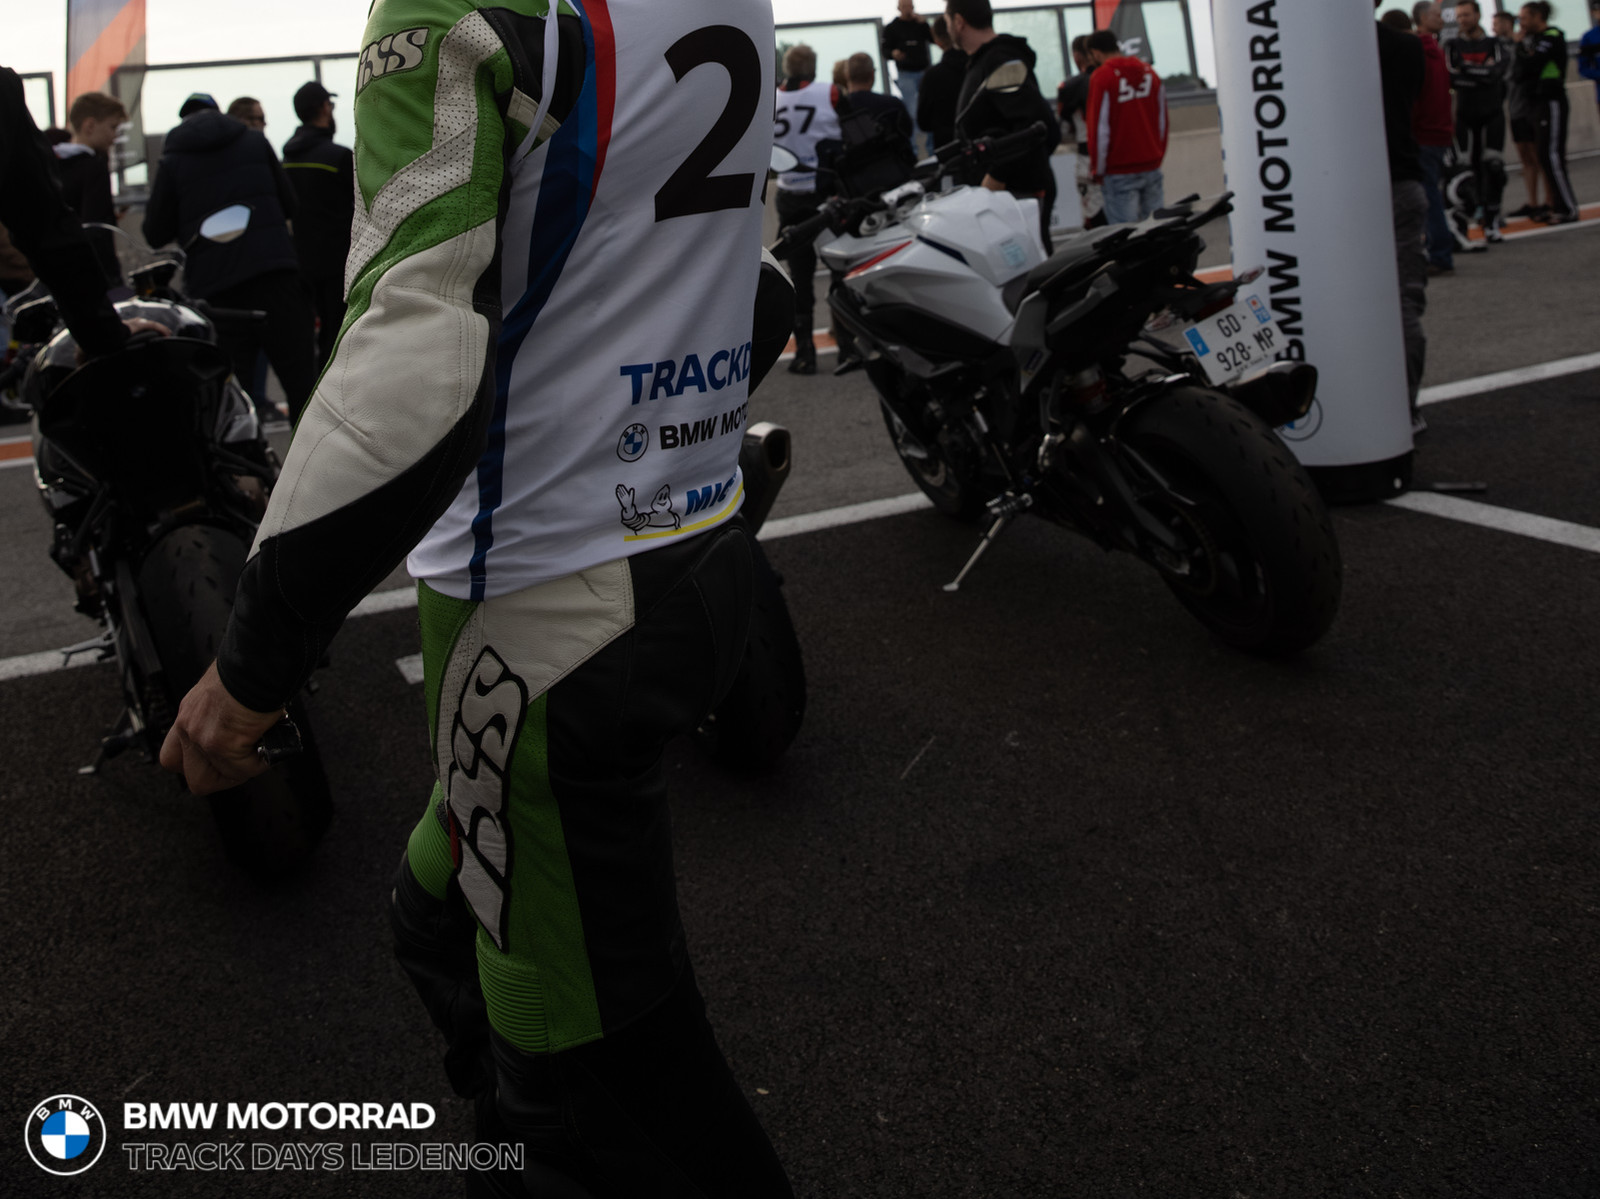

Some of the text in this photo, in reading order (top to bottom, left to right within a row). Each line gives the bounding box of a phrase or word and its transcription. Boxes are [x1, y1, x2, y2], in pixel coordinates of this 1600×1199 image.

[654, 24, 775, 223] 2
[659, 415, 718, 450] BMW
[685, 472, 737, 516] MIC
